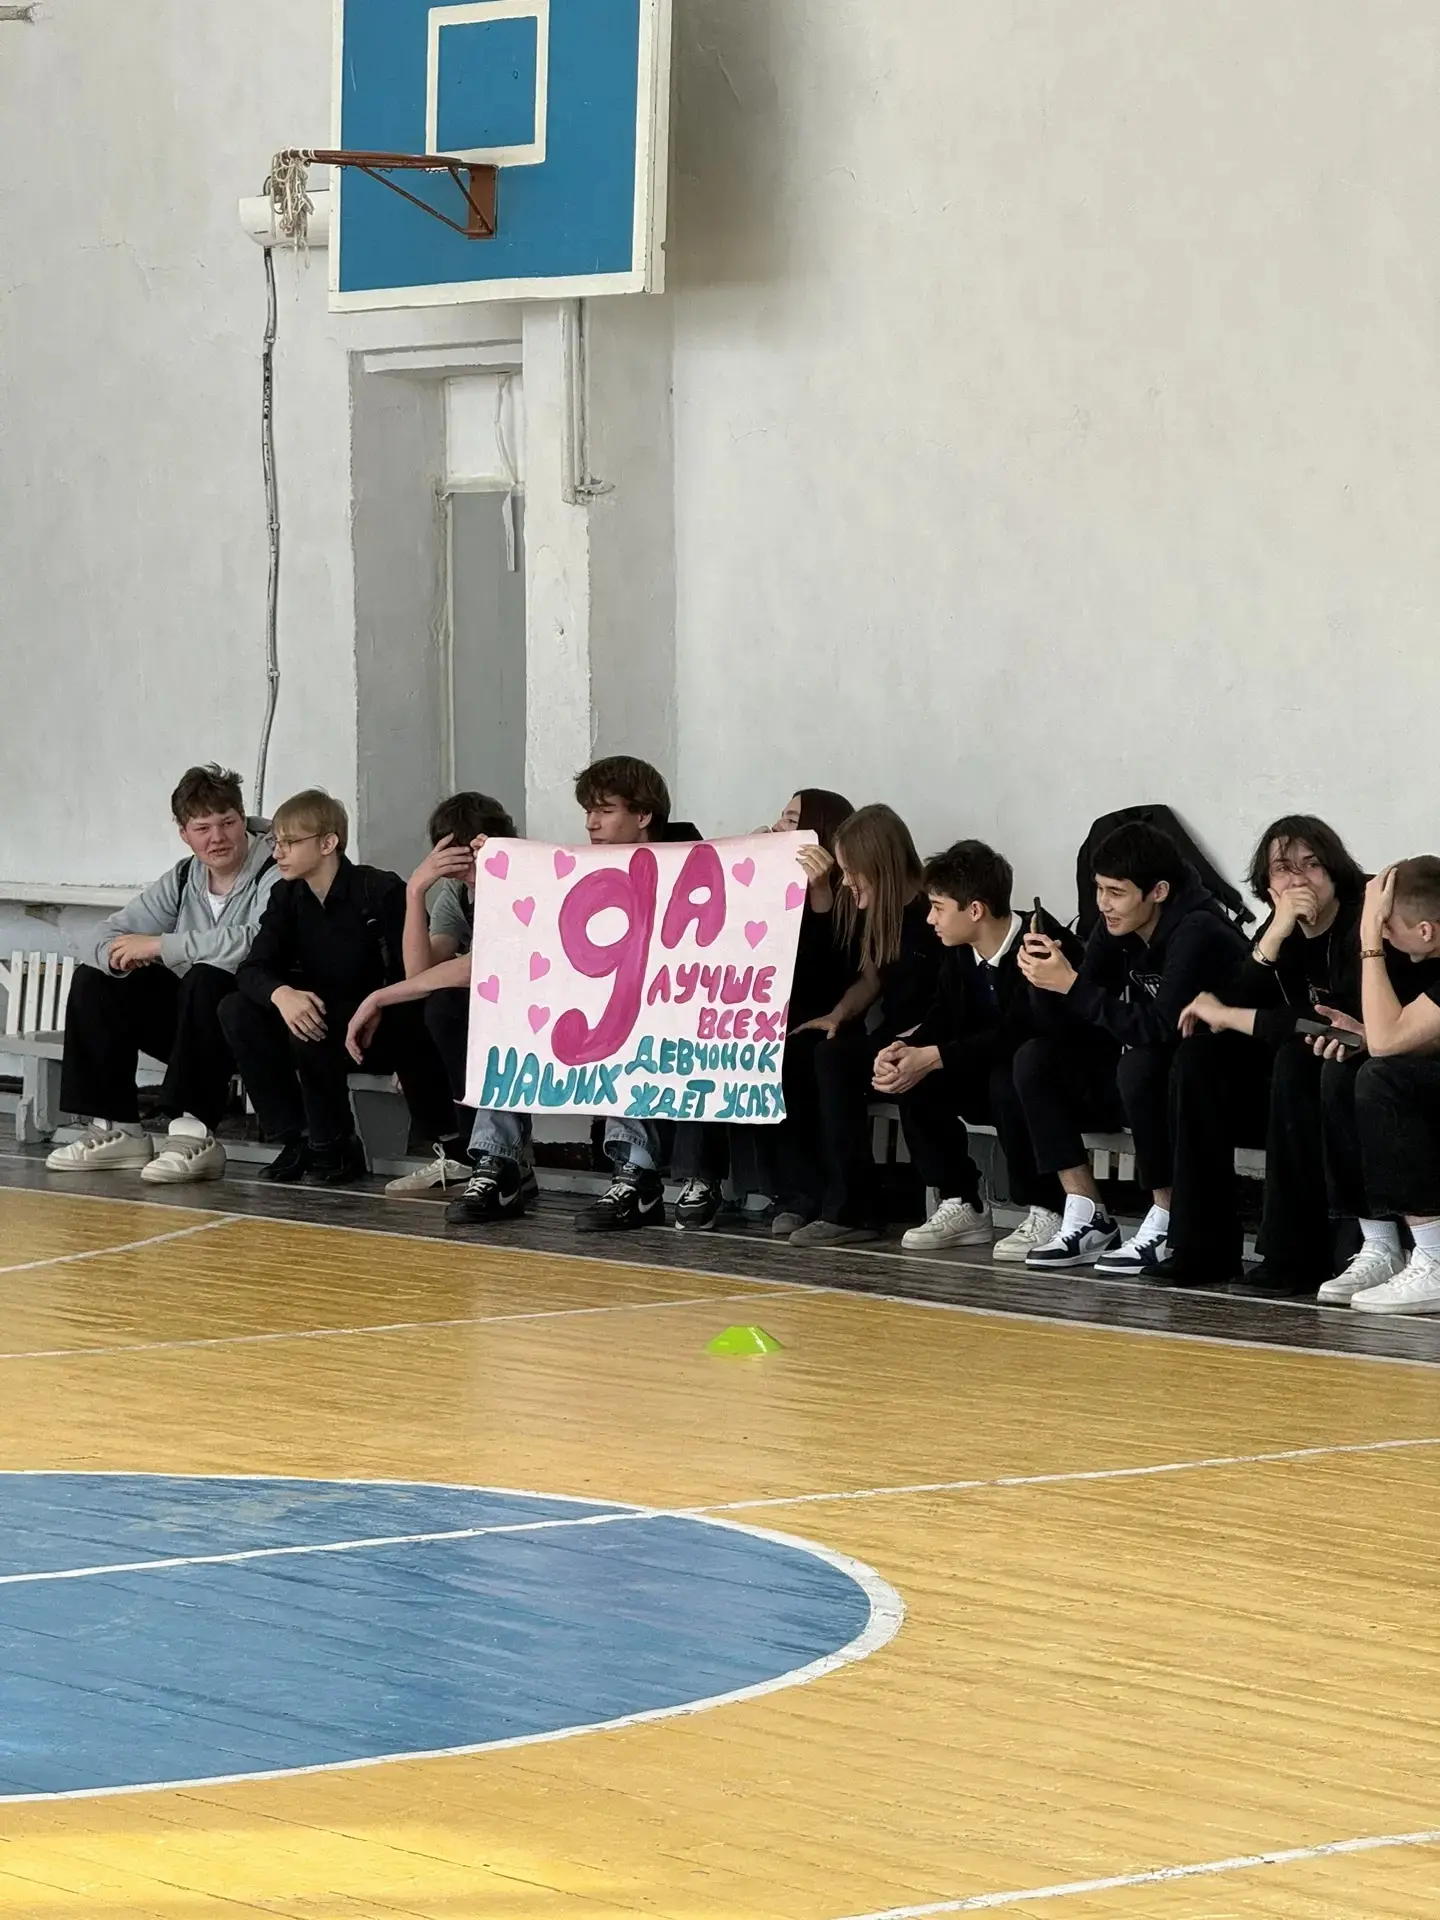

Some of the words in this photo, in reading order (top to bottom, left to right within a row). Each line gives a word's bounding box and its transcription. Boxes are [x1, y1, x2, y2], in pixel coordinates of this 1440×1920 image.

[647, 962, 777, 1006] ЛУЧШЕ
[697, 1000, 789, 1042] ВСЕХ!
[479, 1046, 623, 1108] НАШИХ
[624, 1036, 780, 1075] ДЕВЧОНОК
[624, 1079, 716, 1118] ЖДЕТ
[714, 1082, 787, 1118] УСПЕХ
